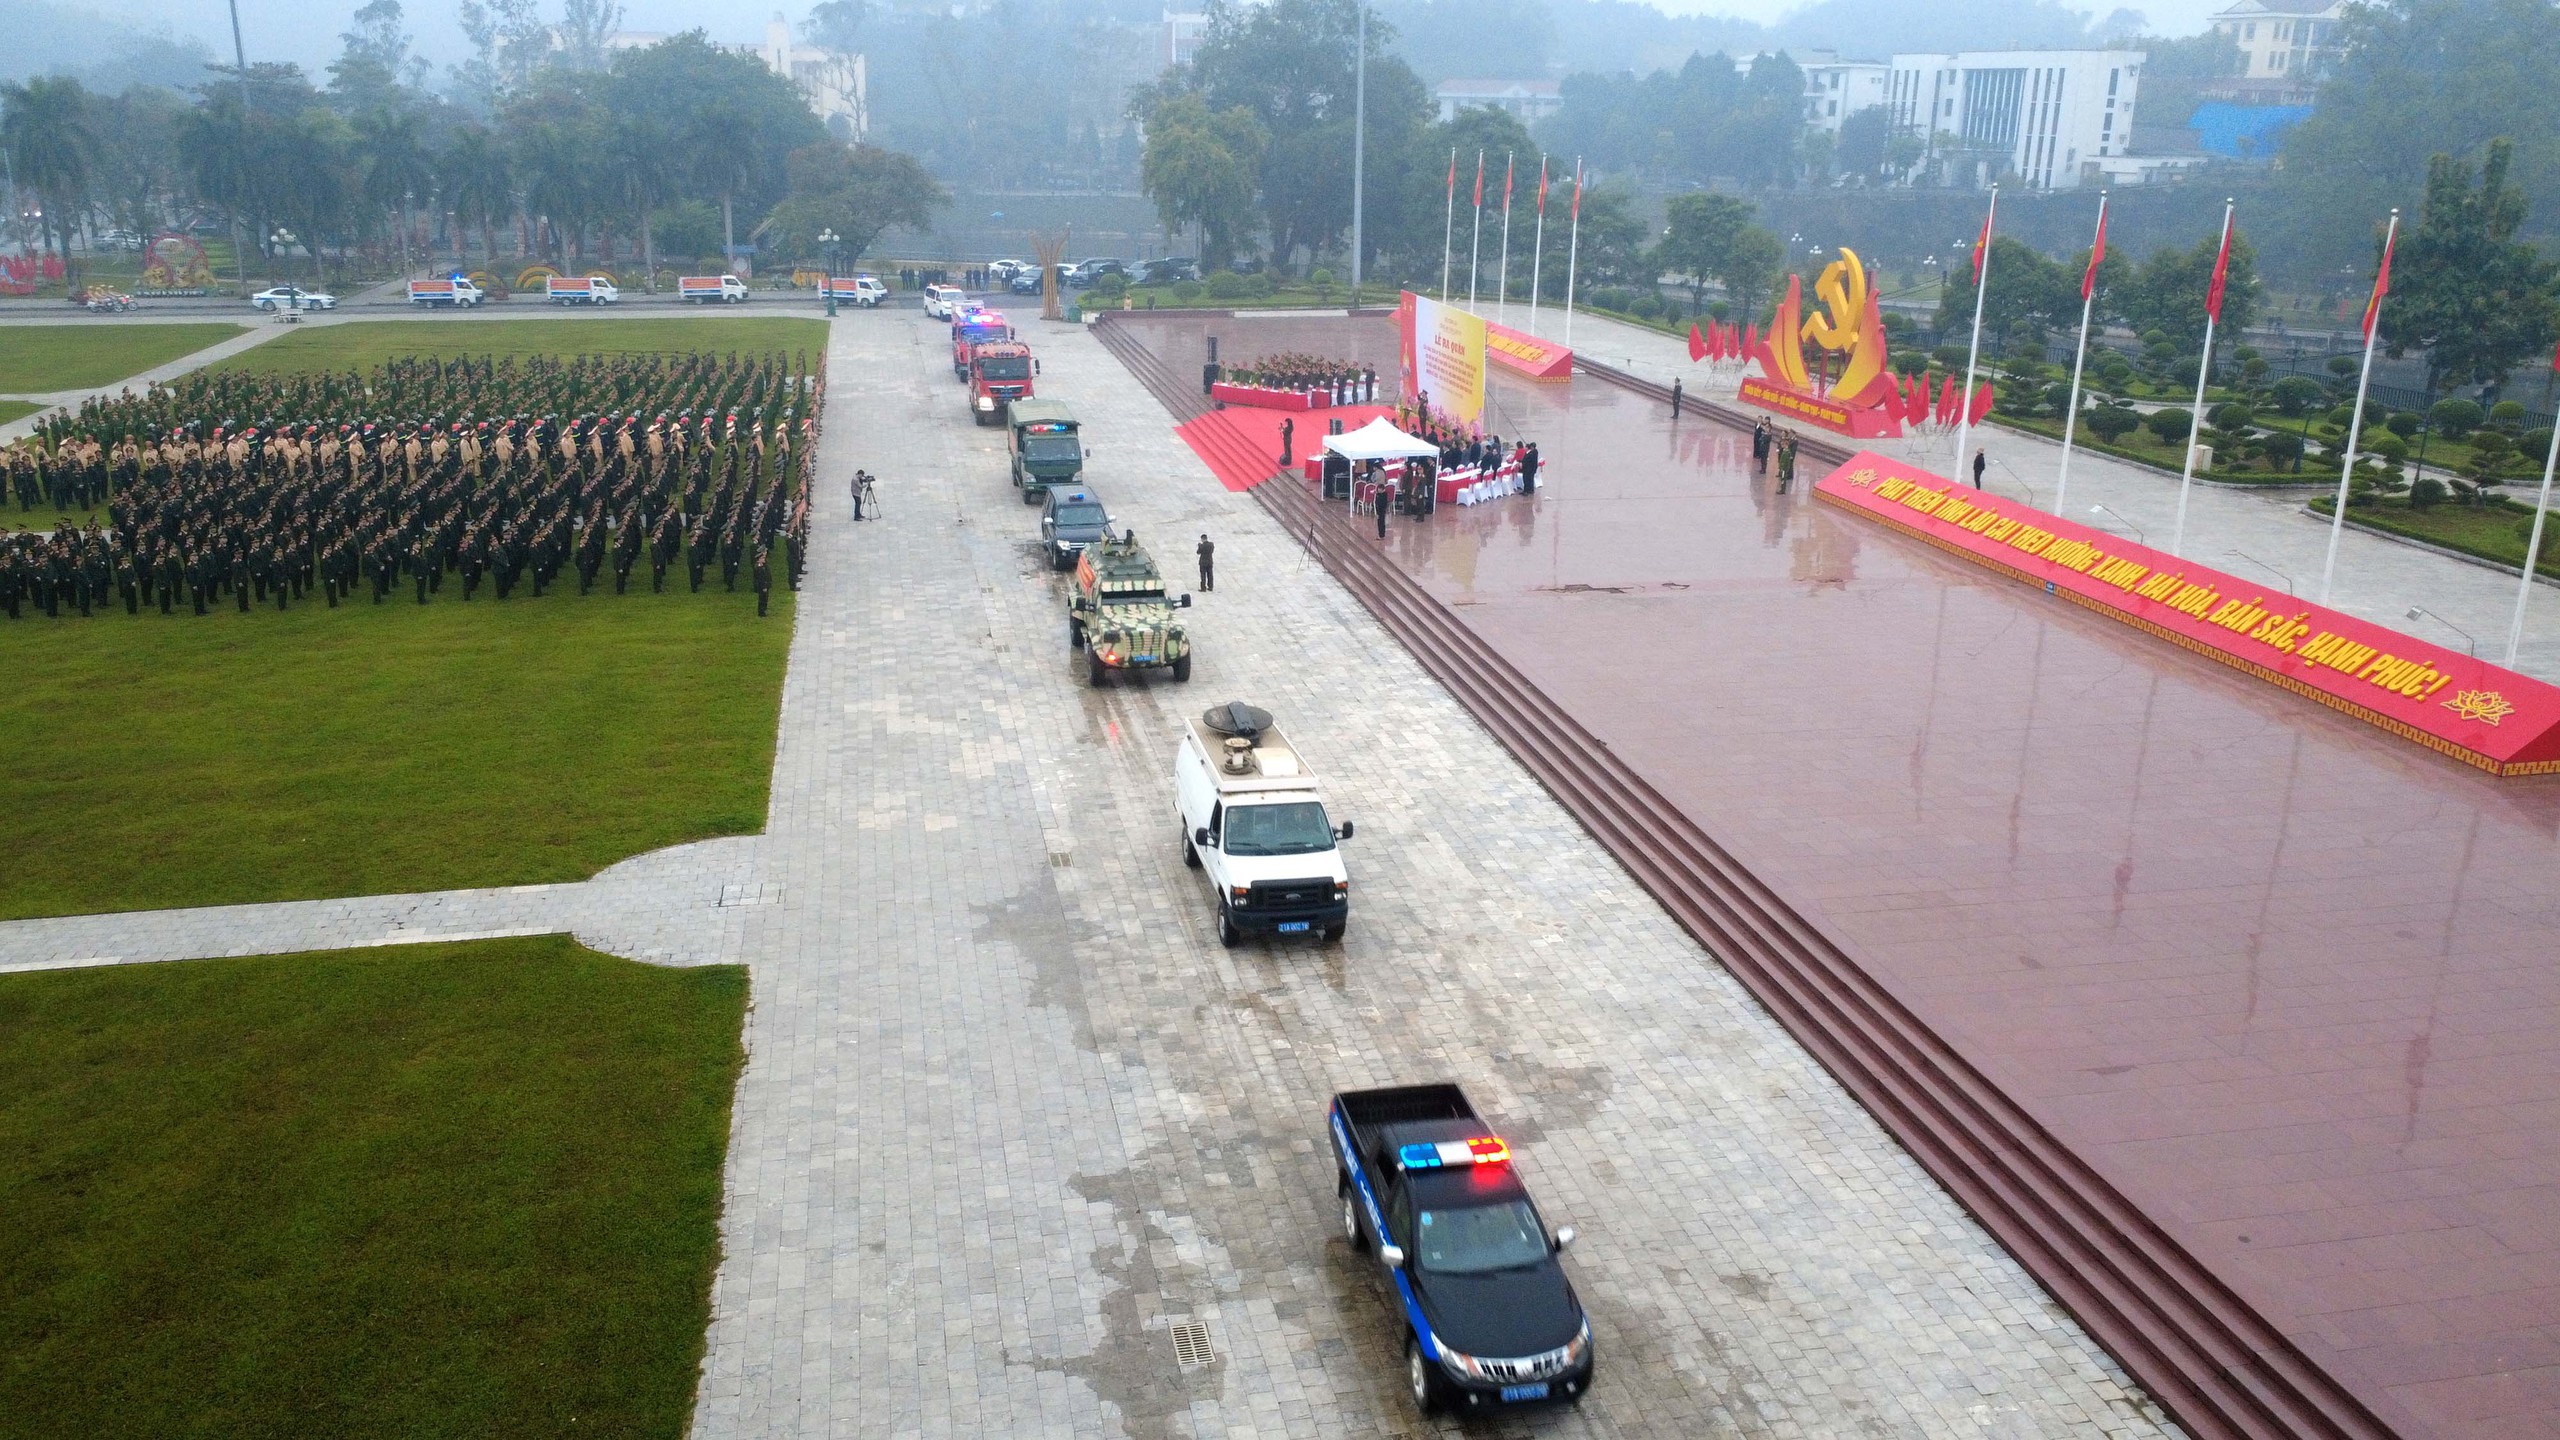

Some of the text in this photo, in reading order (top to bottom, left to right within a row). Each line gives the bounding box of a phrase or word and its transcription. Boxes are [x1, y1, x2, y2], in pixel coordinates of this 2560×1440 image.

[1871, 476, 1916, 502] PHÁT
[1958, 507, 2000, 535] LÀO
[1983, 517, 2024, 542] CAI
[2006, 524, 2056, 555] THEO
[2038, 537, 2105, 574] HƯỚNG
[2086, 555, 2151, 594] XANH,
[2134, 572, 2185, 604] HÀI
[2207, 596, 2270, 635] BẢN
[2250, 612, 2311, 655] SẮC,
[2296, 631, 2380, 675] HẠNH
[2356, 653, 2452, 703] PHÚC!
